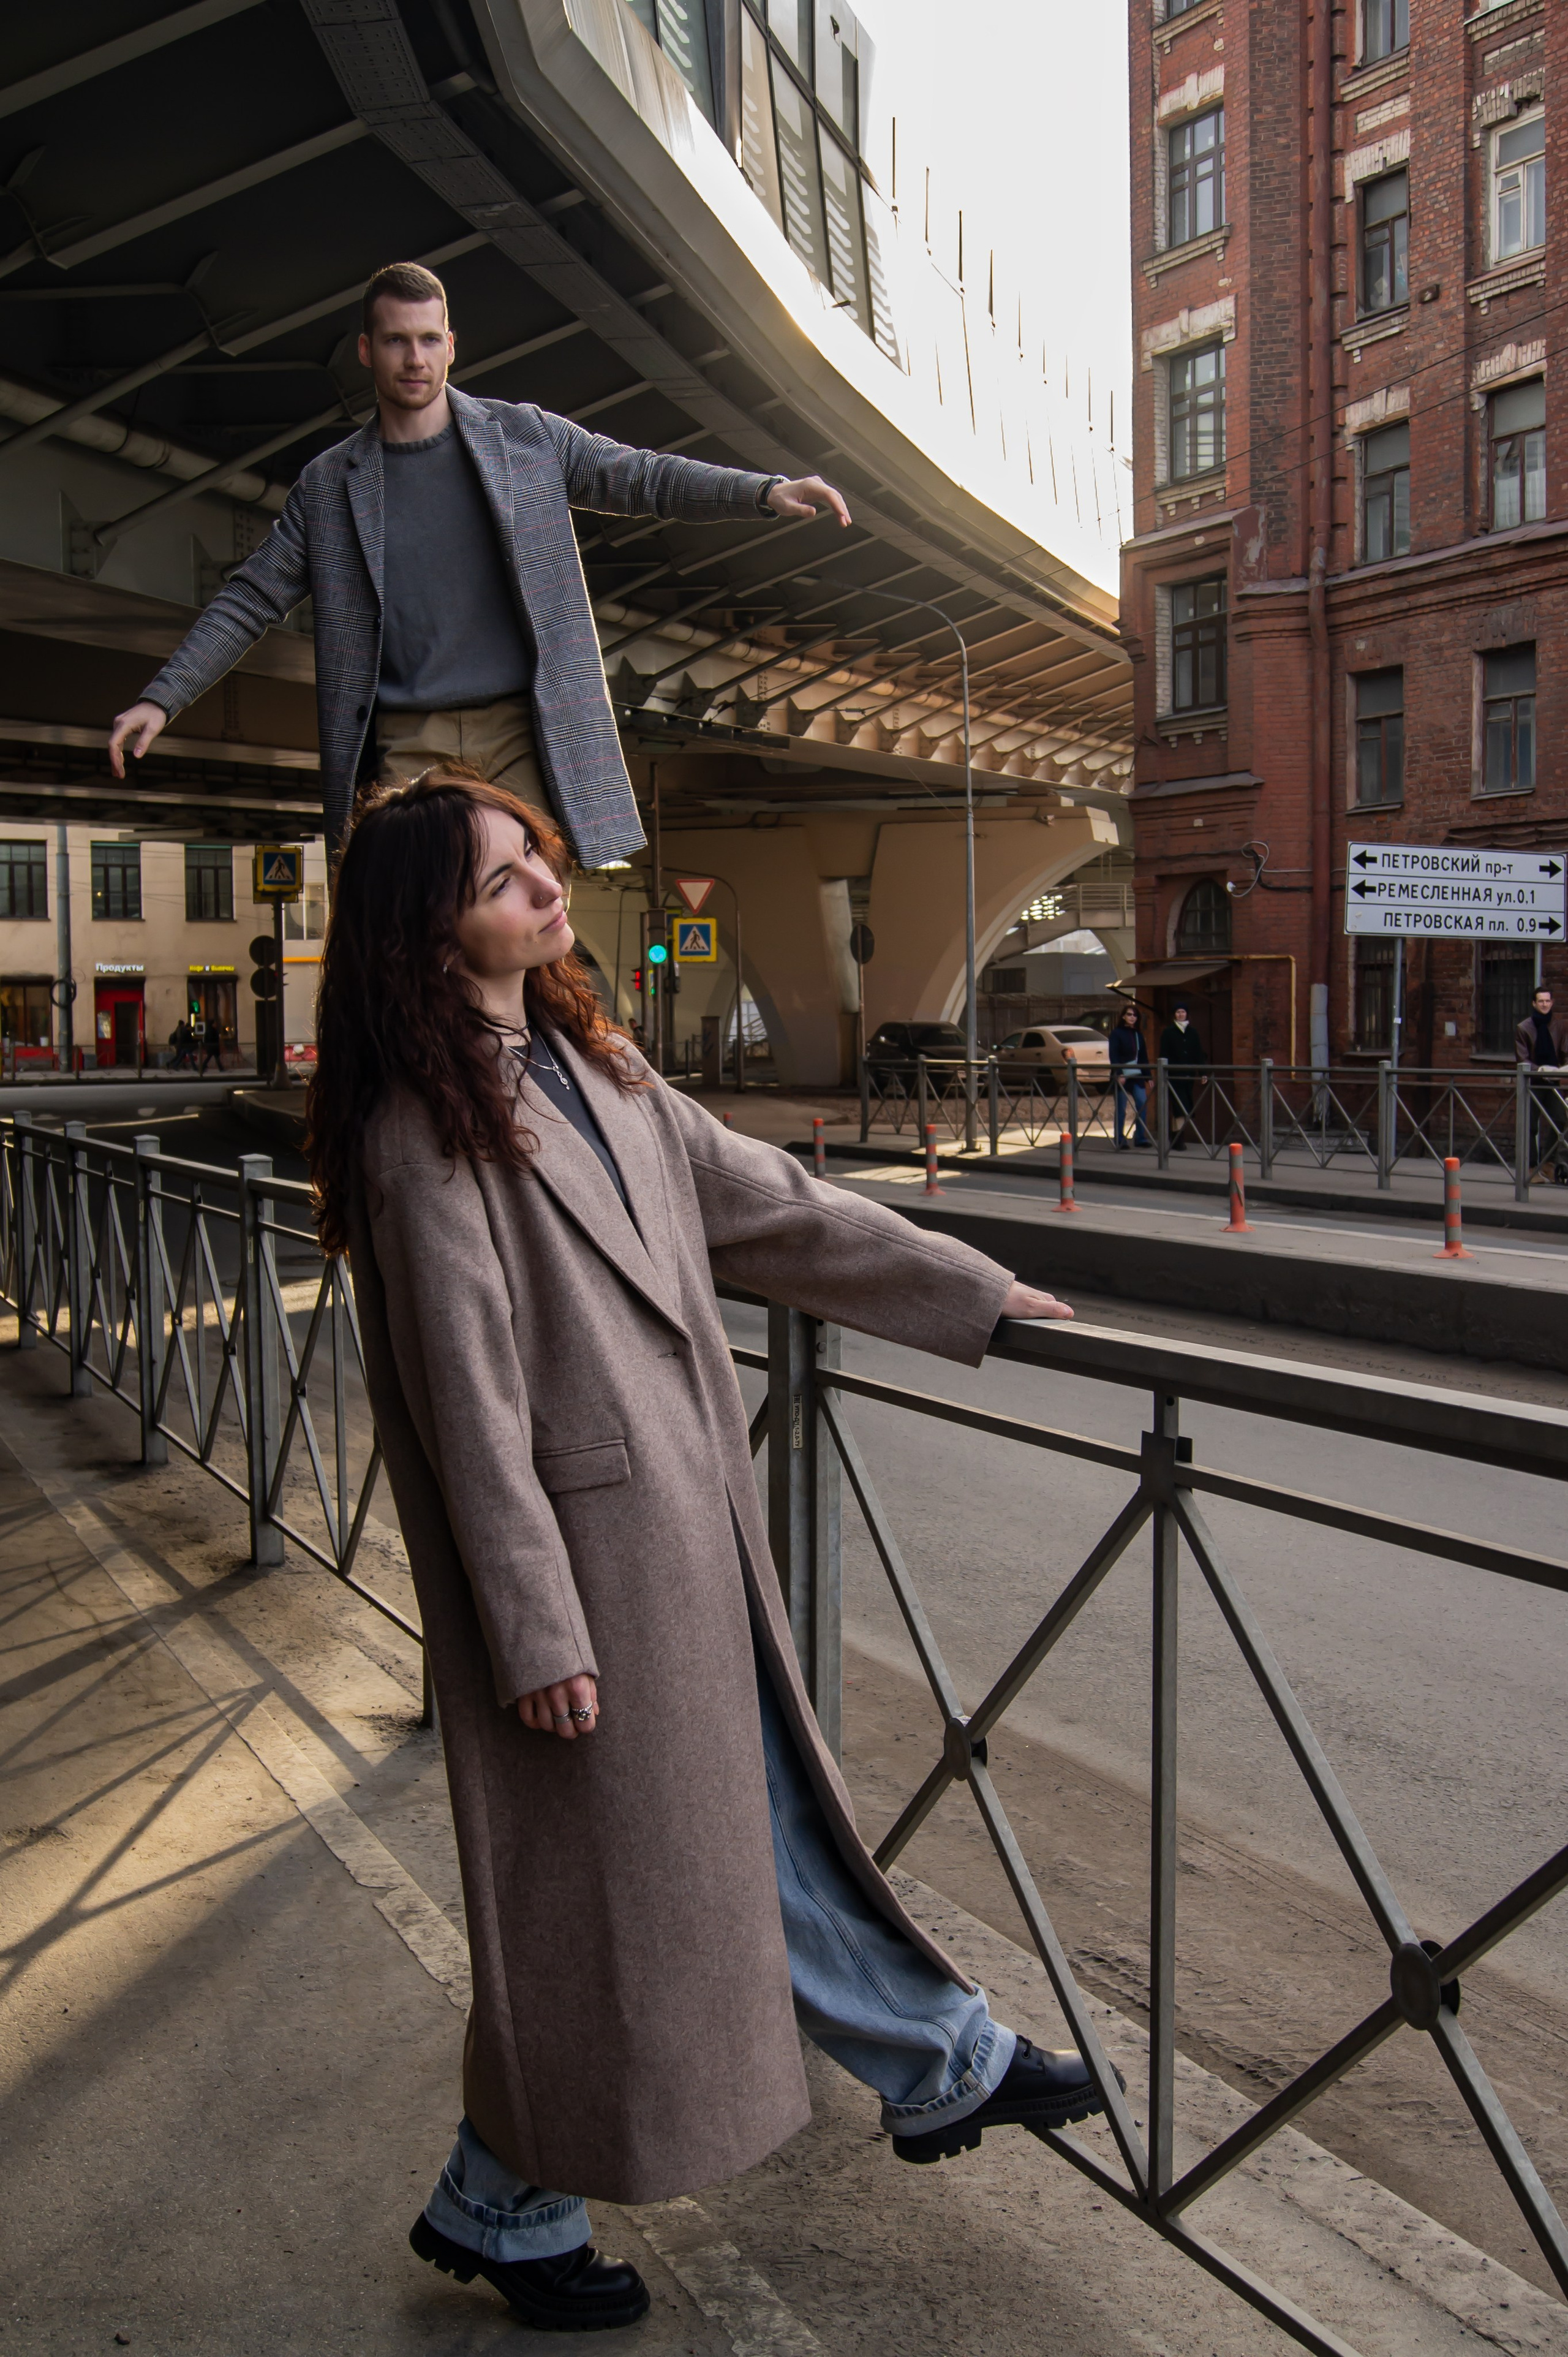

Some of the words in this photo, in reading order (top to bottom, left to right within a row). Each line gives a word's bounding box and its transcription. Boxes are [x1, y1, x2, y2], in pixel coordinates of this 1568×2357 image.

[1382, 853, 1480, 872] ПЕТРОВСКИЙ
[1485, 863, 1513, 877] пр-т
[1378, 882, 1492, 902] РЕМЕСЛЕННАЯ
[1384, 912, 1484, 931] ПЕТРОВСКАЯ
[1489, 920, 1509, 931] пл.
[1517, 917, 1537, 933] 0,9
[96, 963, 144, 973] Продукты
